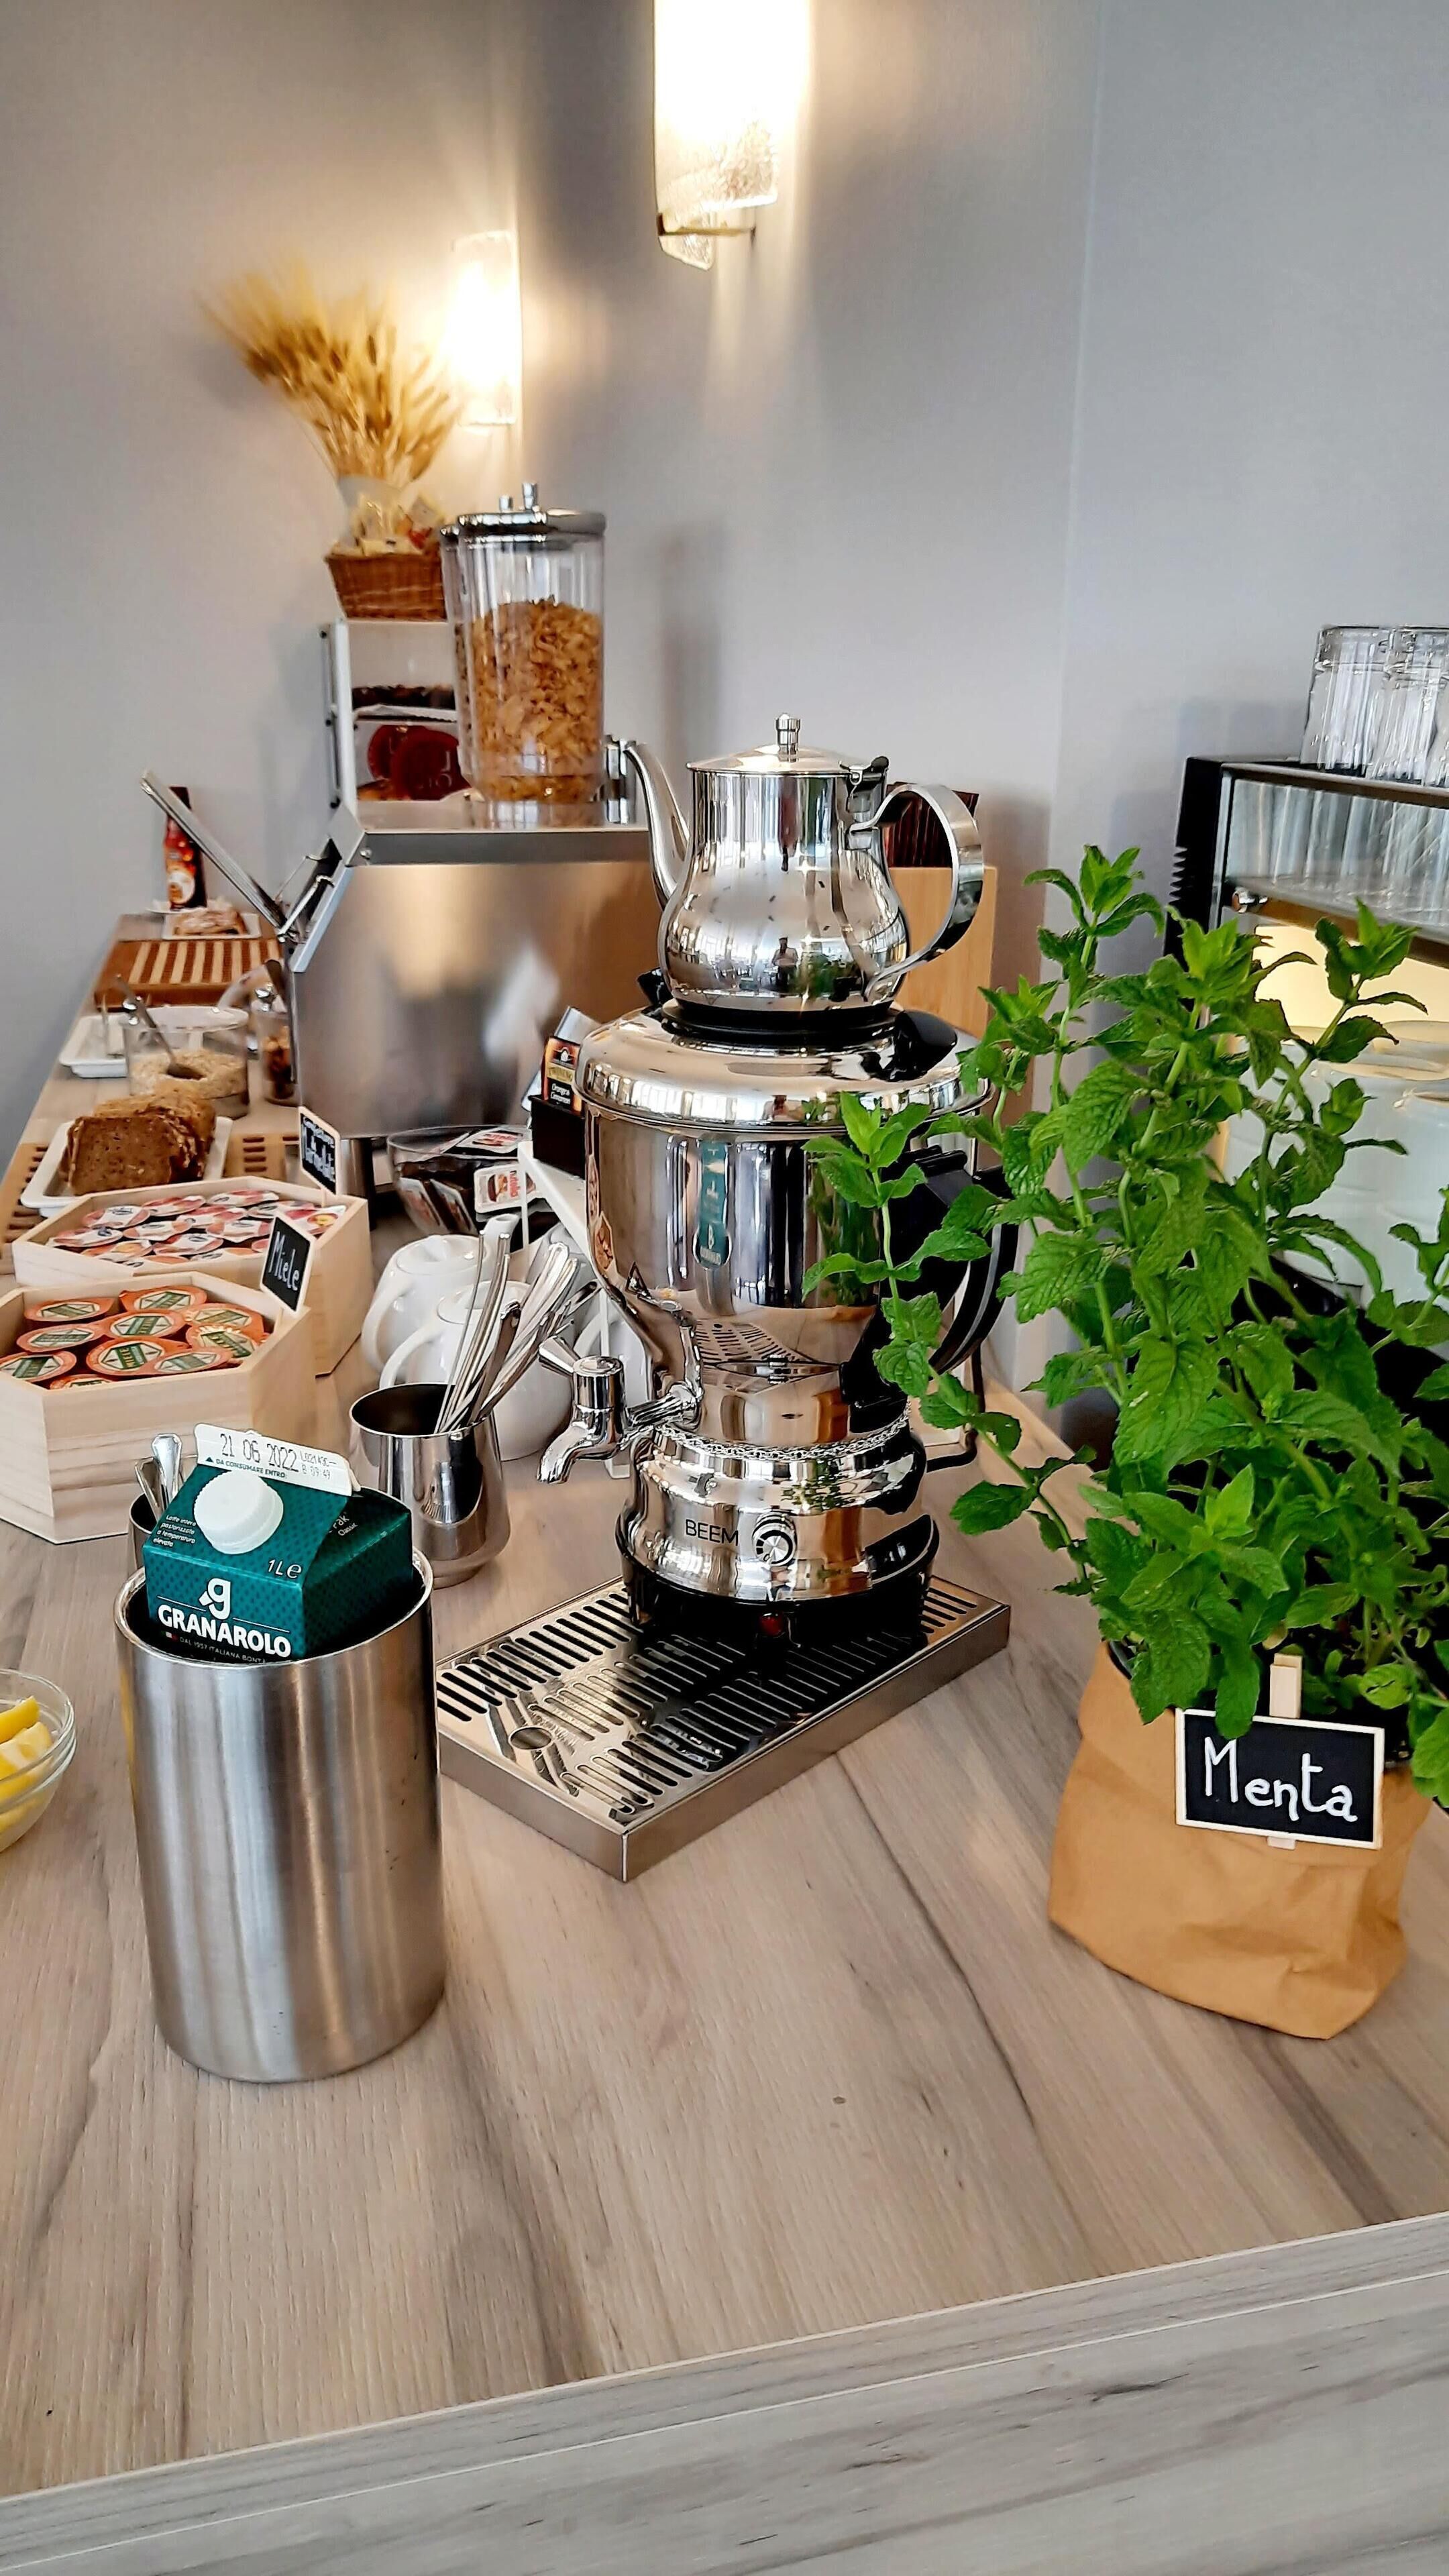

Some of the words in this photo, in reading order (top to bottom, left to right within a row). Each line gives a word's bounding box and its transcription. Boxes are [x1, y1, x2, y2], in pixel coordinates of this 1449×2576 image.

[268, 1230, 300, 1291] Miele
[220, 1433, 235, 1458] 21
[243, 1439, 261, 1463] 06
[267, 1443, 299, 1472] 2022
[685, 1519, 739, 1547] BEEM
[158, 1604, 292, 1658] GRANAROLO
[180, 1636, 192, 1646] DAL
[209, 1646, 241, 1660] ITALIANA
[1204, 1736, 1358, 1823] Menta
